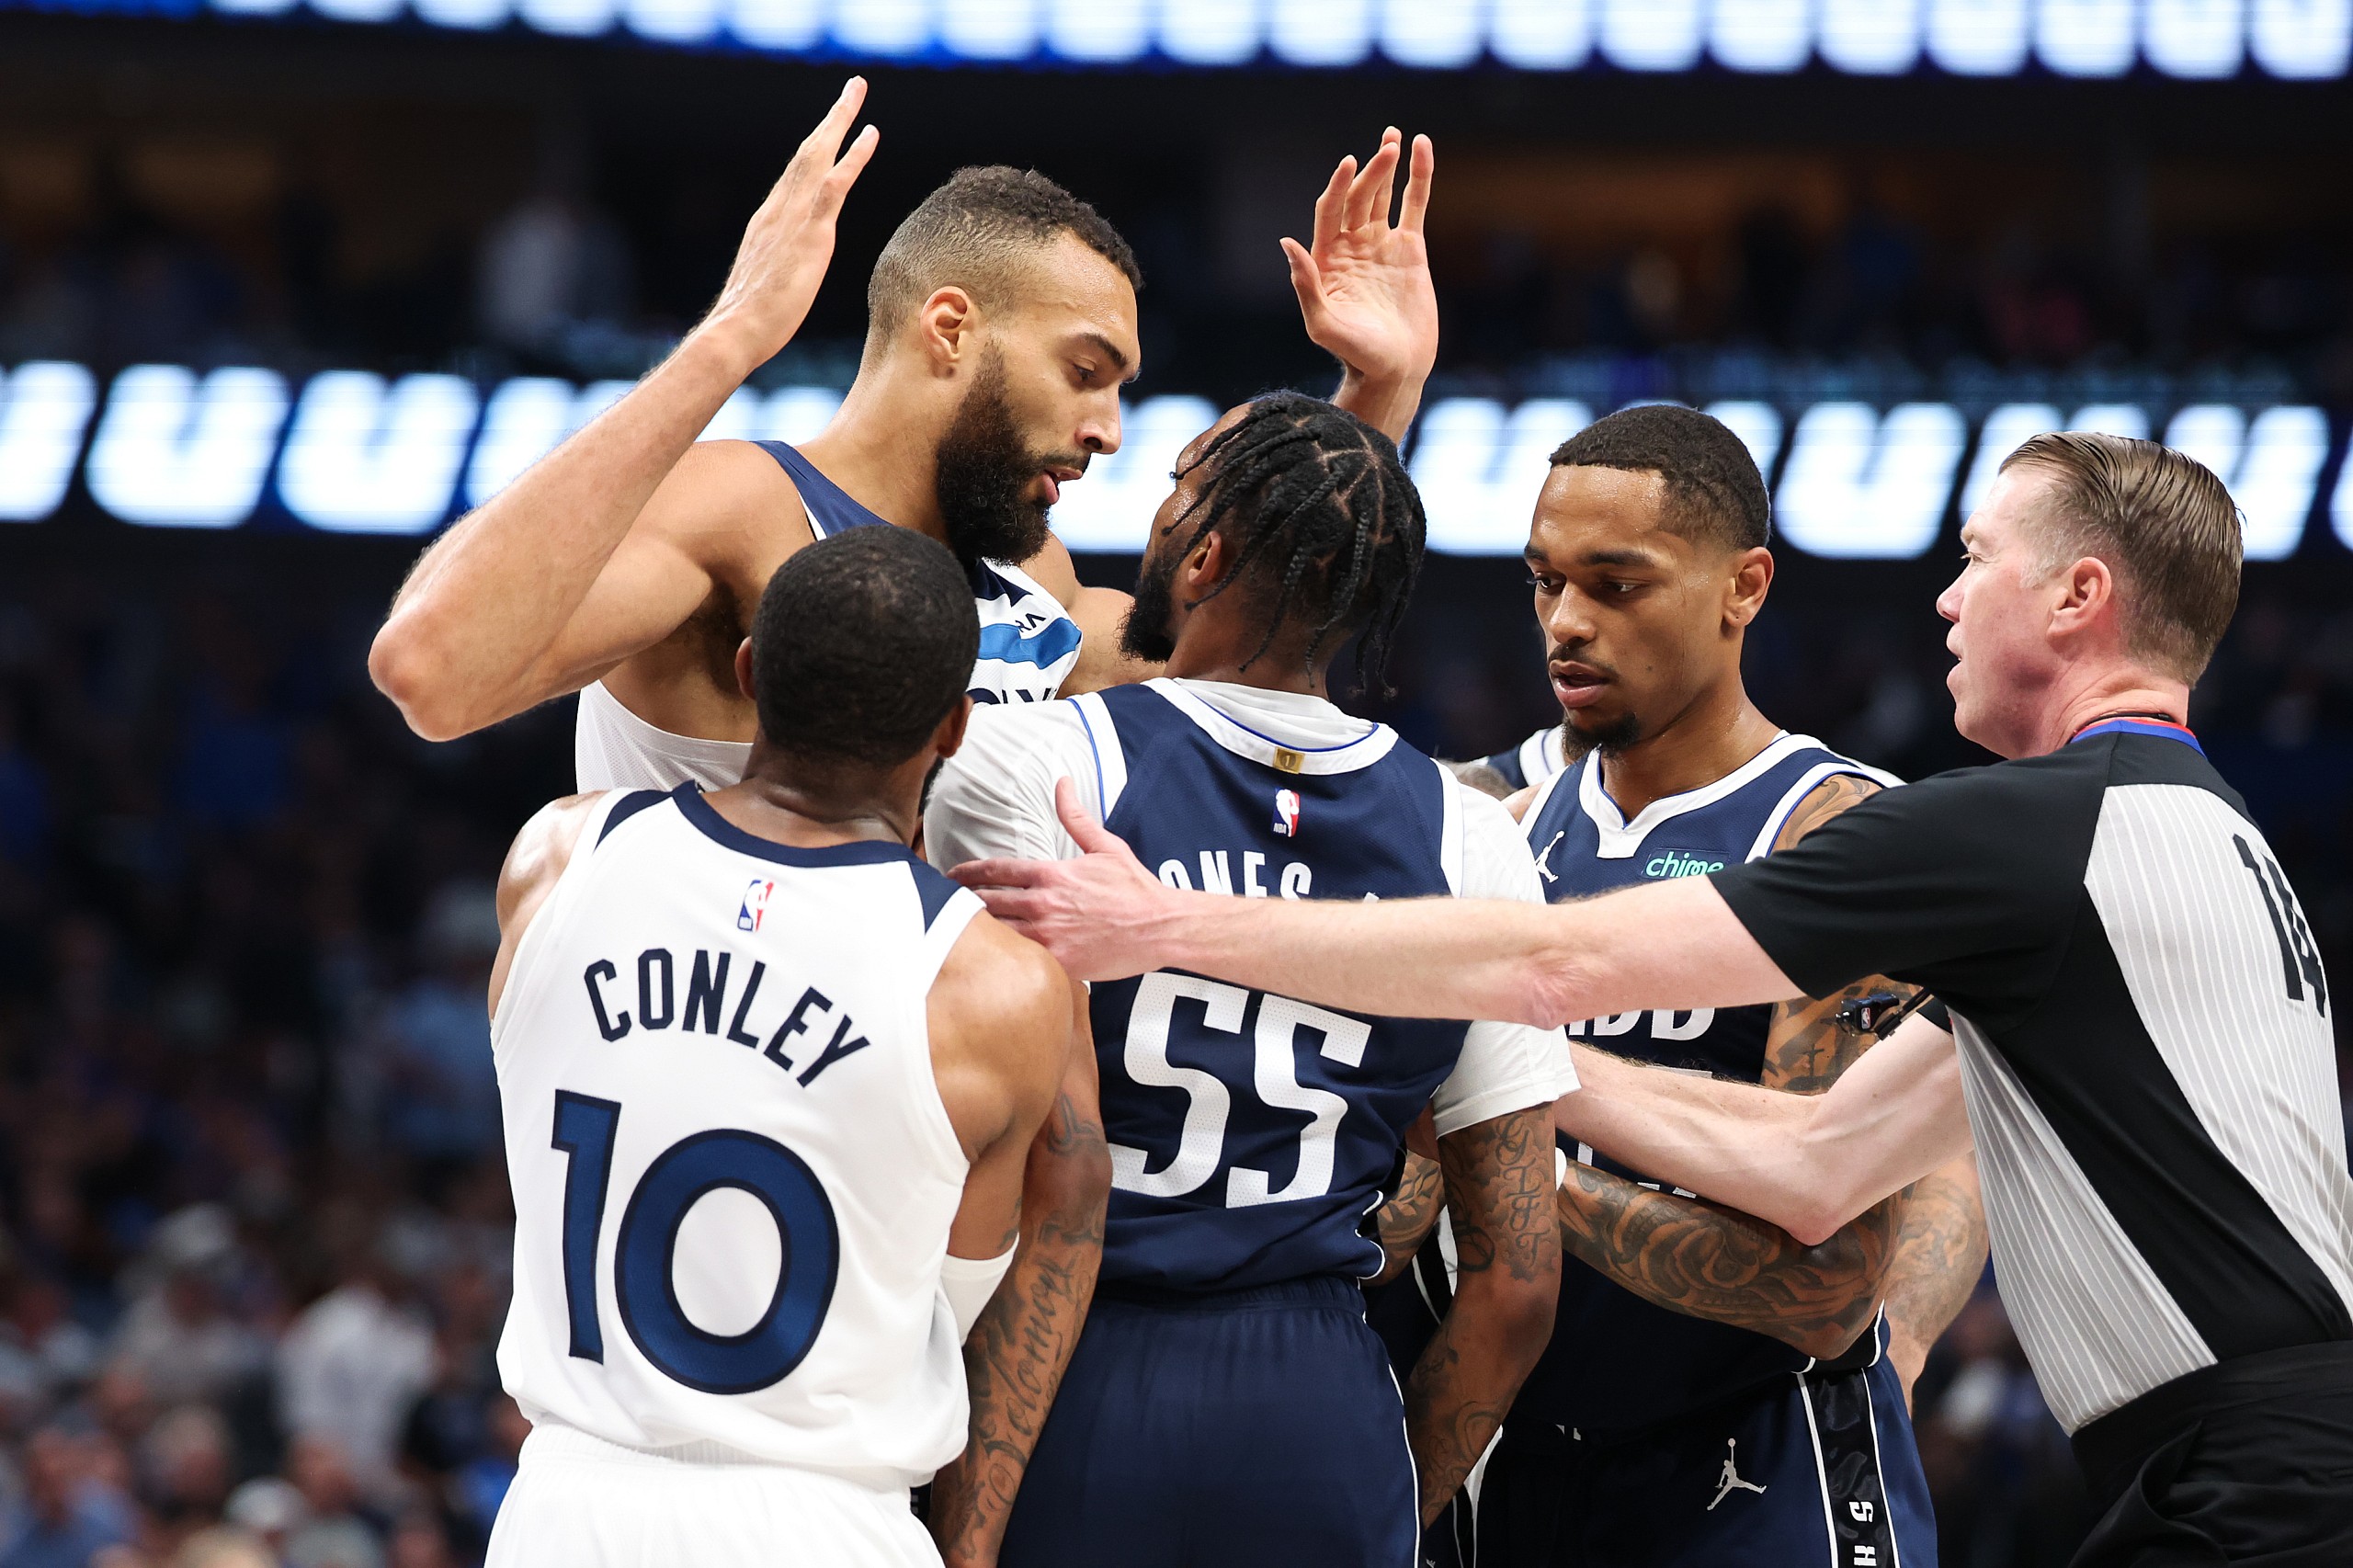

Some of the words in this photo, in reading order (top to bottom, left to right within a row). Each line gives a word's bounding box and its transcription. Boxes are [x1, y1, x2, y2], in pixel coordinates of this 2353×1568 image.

[1645, 851, 1724, 878] chime
[584, 948, 870, 1087] CONLEY
[1111, 971, 1372, 1209] 55
[551, 1088, 840, 1395] 10
